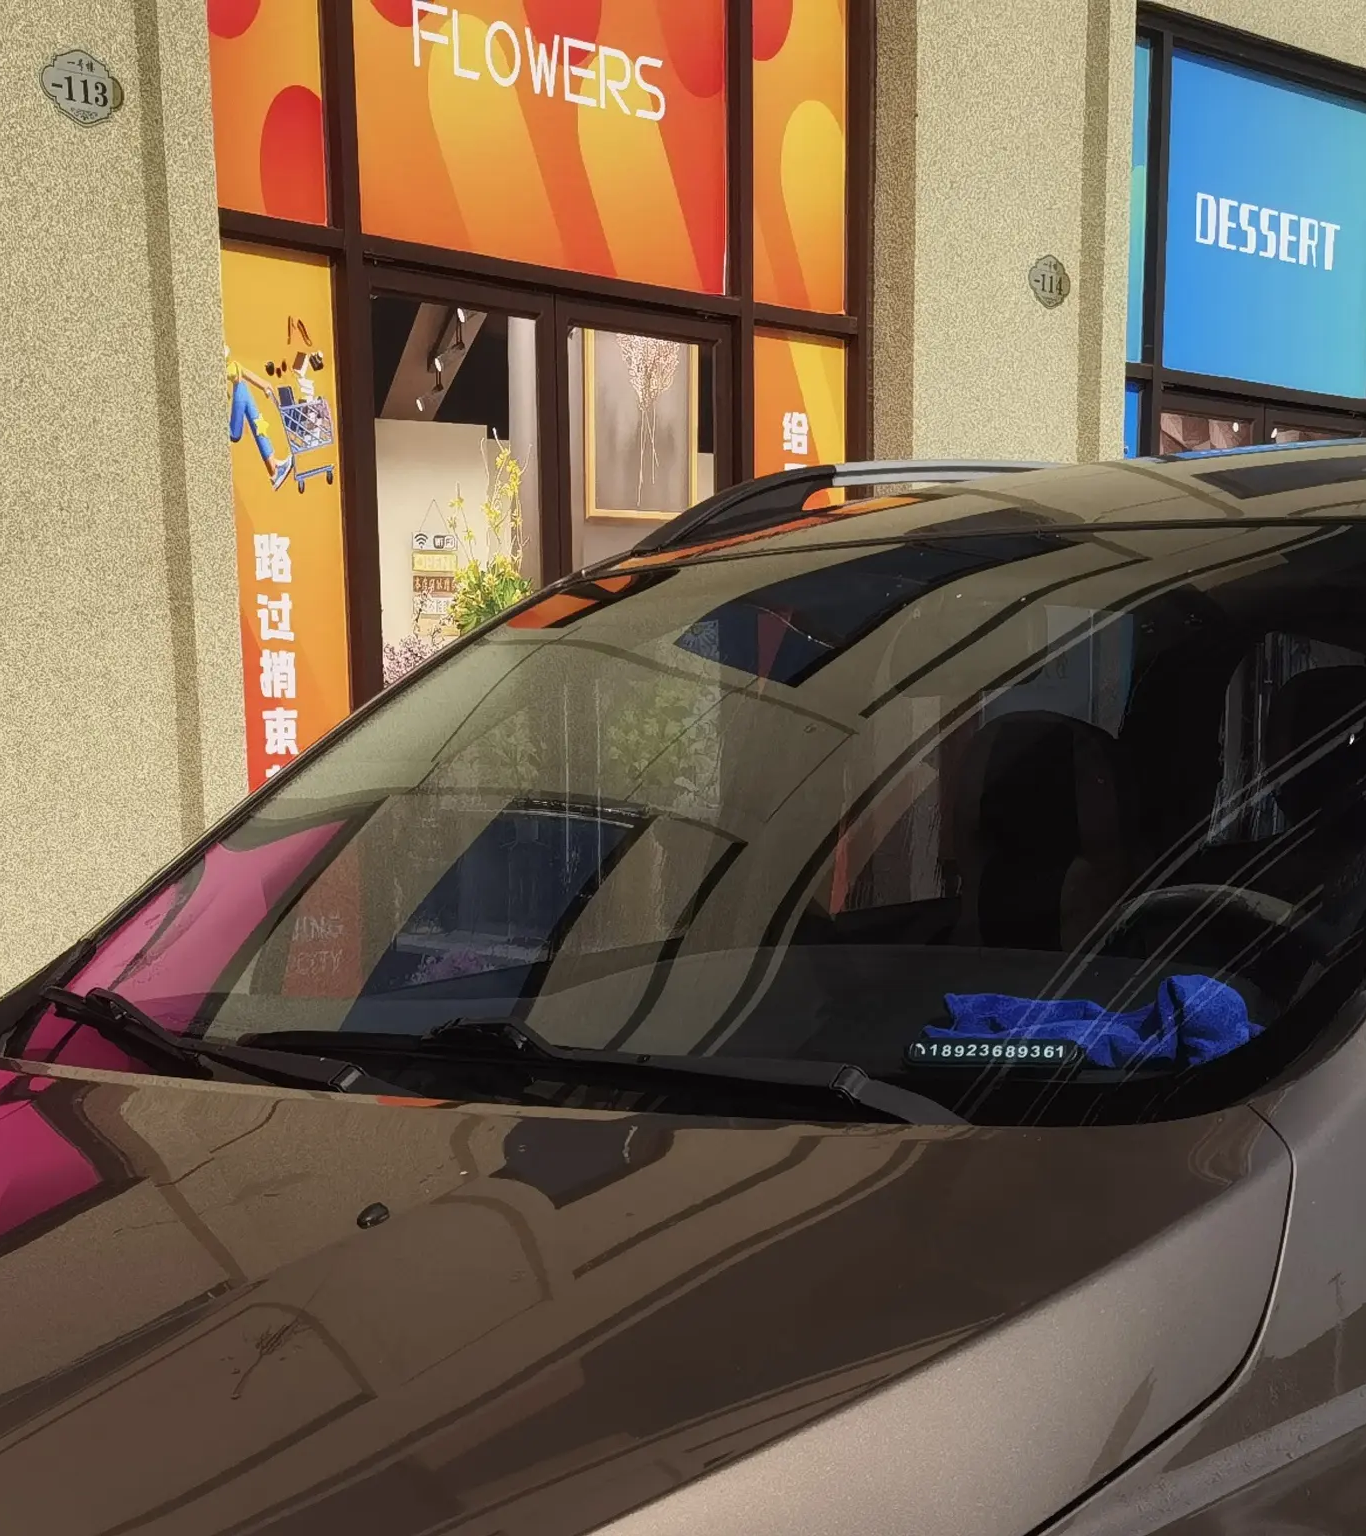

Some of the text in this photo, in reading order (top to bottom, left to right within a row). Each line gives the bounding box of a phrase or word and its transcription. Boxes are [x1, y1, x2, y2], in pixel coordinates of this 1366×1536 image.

[412, 0, 666, 121] FLOWERS
[51, 76, 108, 107] -113
[1195, 192, 1341, 271] DESSERT
[1033, 274, 1063, 296] -114
[782, 412, 809, 471] 给
[929, 1043, 1064, 1058] 18923689361
